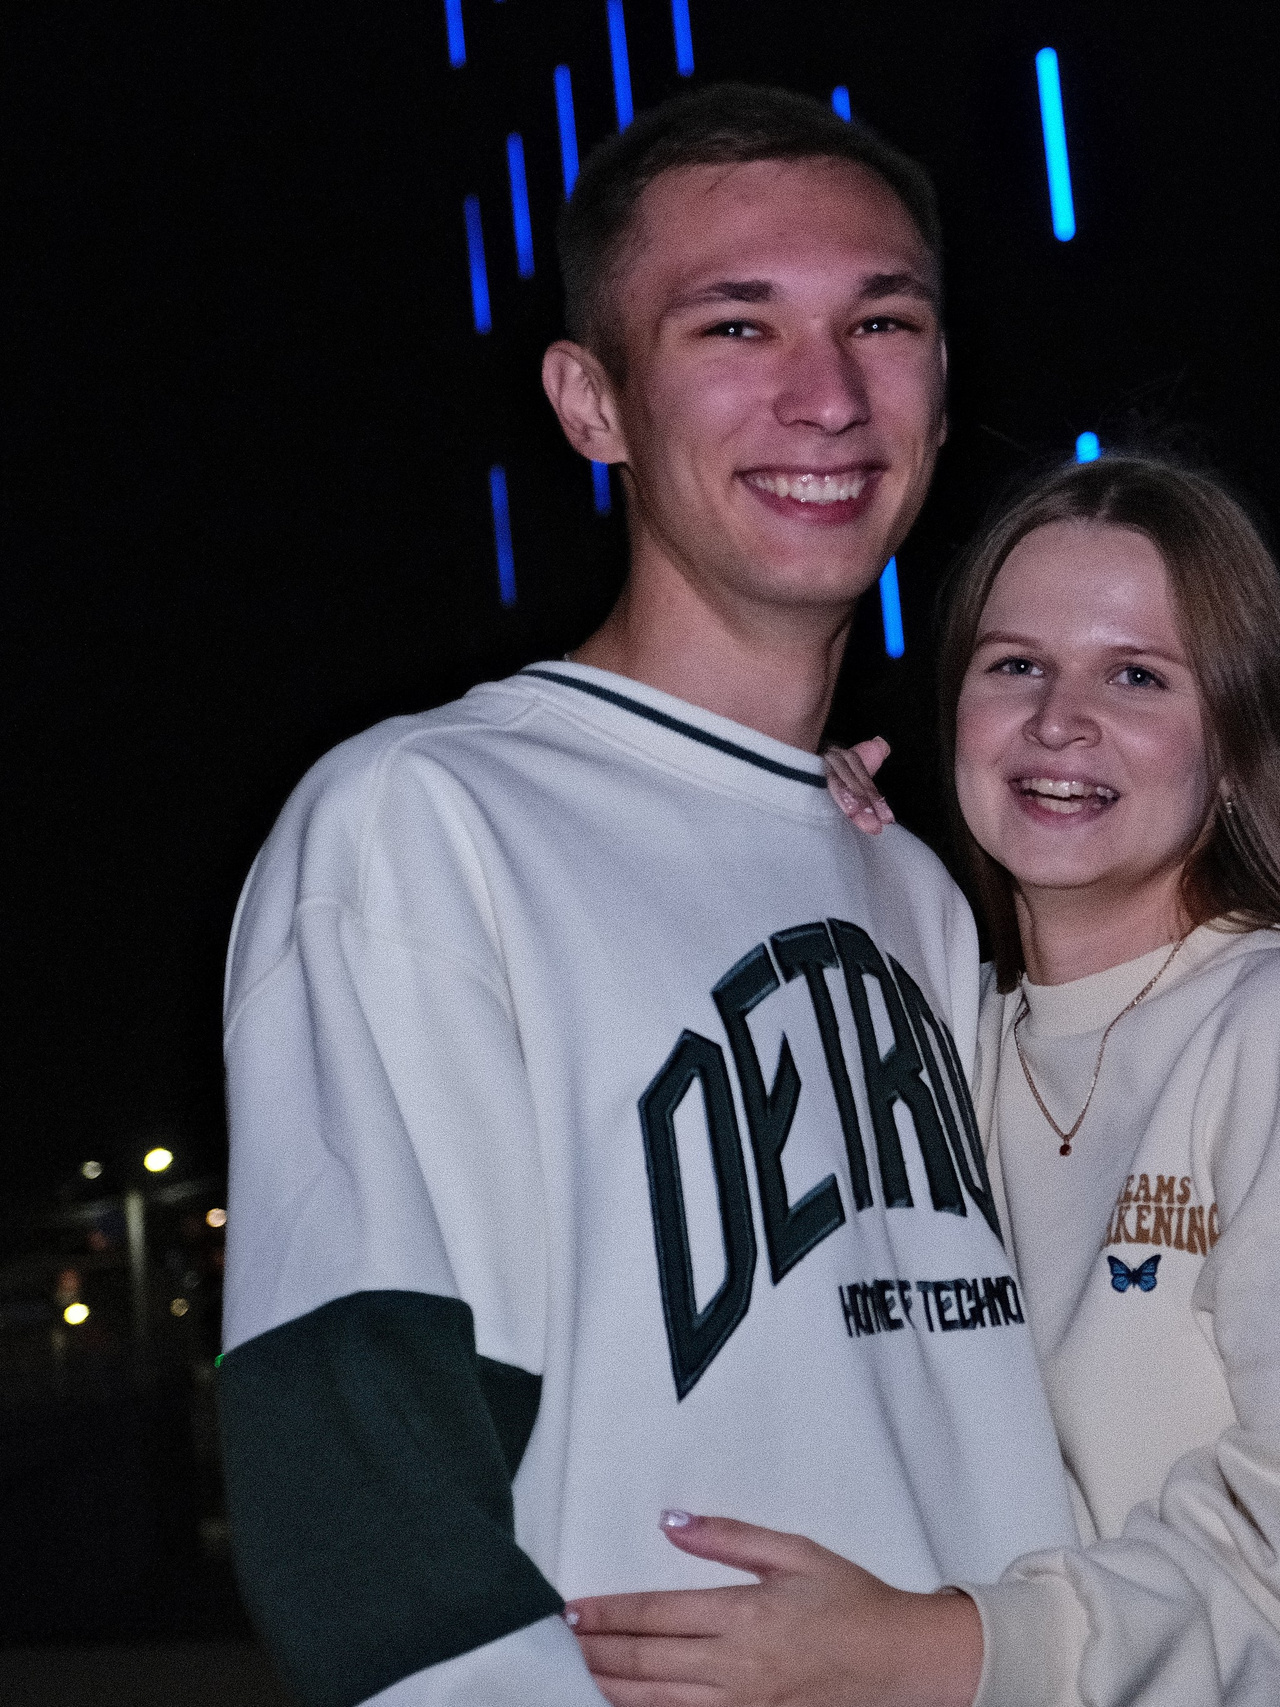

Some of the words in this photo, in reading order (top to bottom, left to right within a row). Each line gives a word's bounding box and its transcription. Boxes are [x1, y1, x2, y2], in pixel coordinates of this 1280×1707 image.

[1117, 1173, 1192, 1204] EAMS
[1104, 1202, 1221, 1257] KENIN
[916, 1275, 1025, 1332] TECHNO
